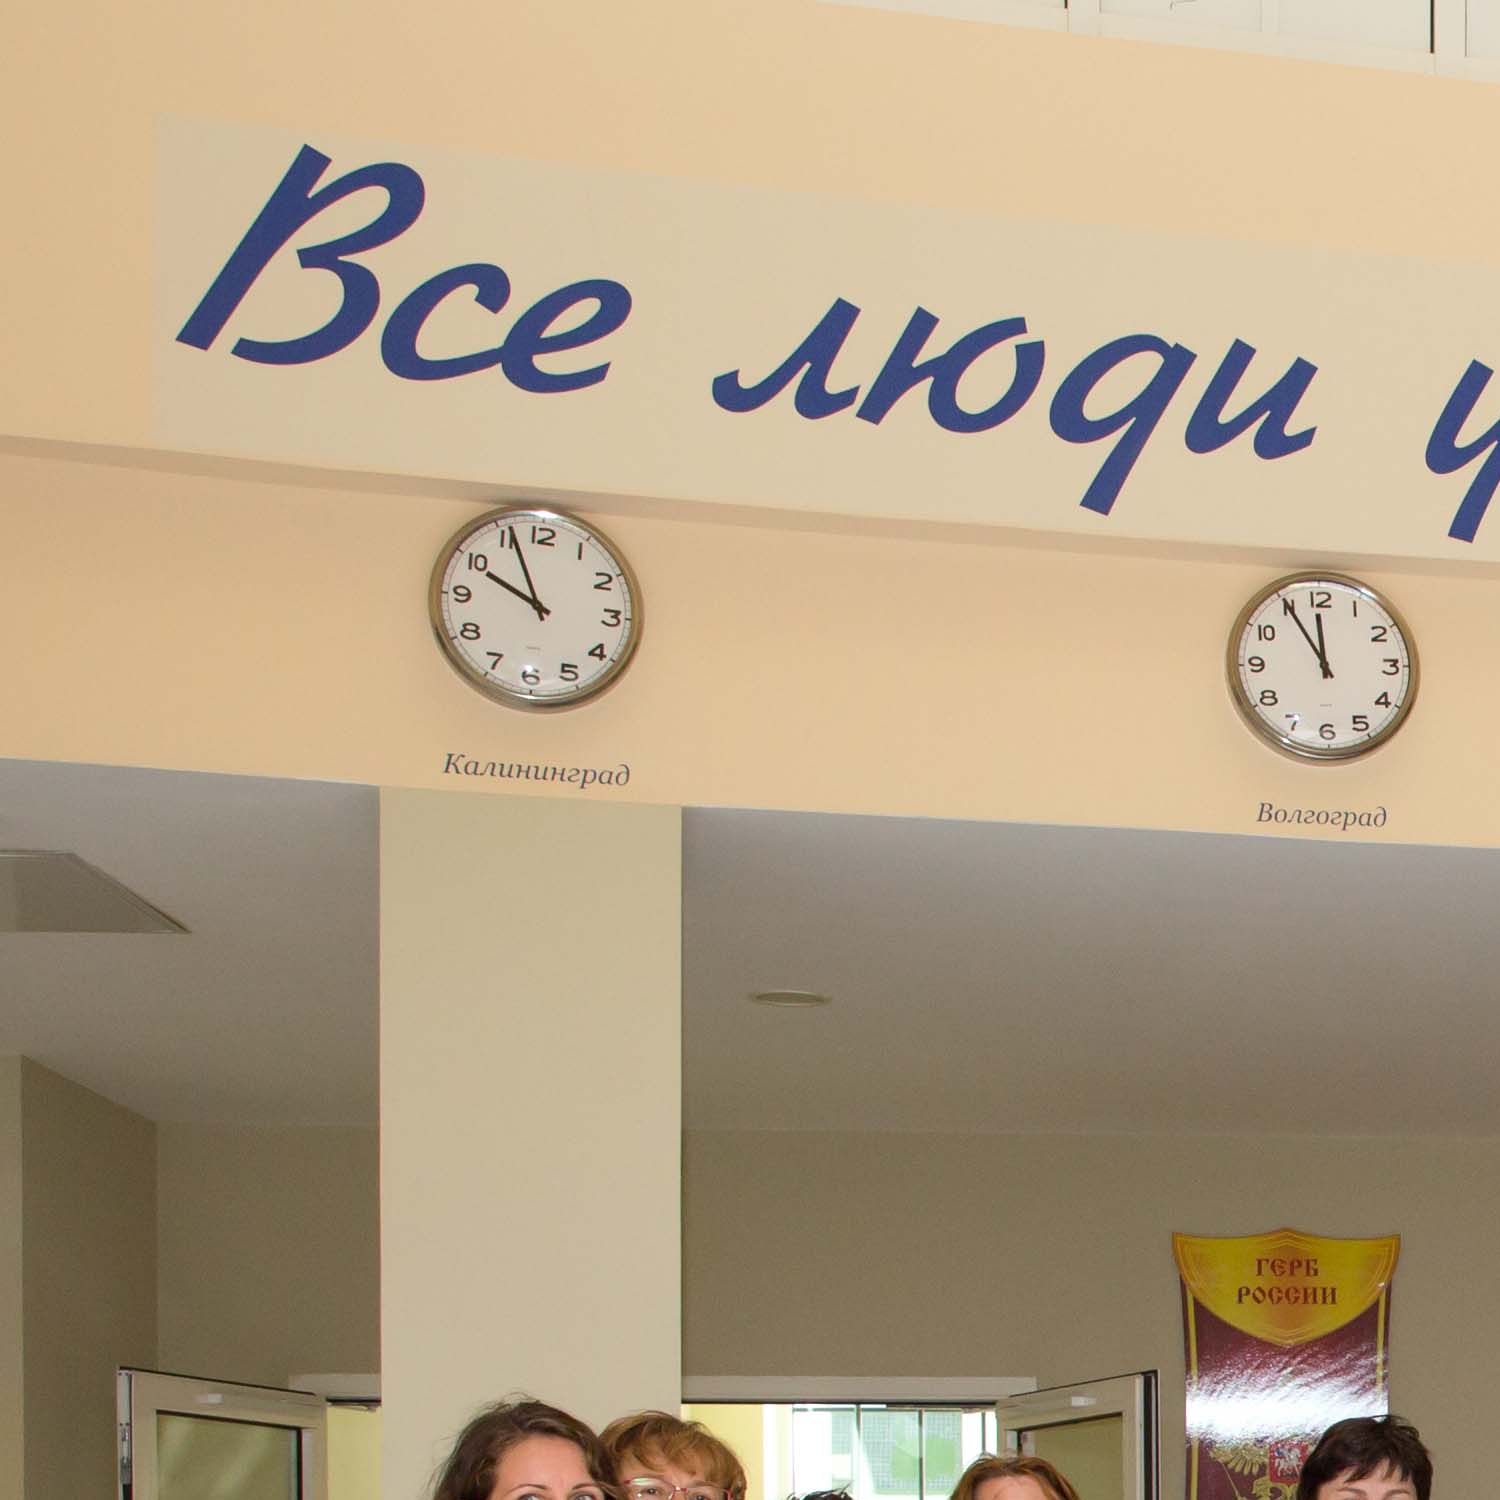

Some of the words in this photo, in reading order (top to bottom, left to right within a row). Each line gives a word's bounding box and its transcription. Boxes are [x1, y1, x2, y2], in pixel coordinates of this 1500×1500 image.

[176, 143, 632, 393] Все
[711, 298, 1317, 515] люди
[531, 525, 556, 547] 12
[578, 542, 583, 560] 1
[467, 552, 488, 572] 10
[593, 572, 613, 591] 2
[452, 584, 472, 603] 9
[1310, 591, 1332, 609] 12
[601, 608, 622, 628] 3
[1353, 600, 1357, 618] 1
[459, 622, 481, 641] 8
[1258, 624, 1275, 641] 10
[1370, 625, 1388, 643] 2
[486, 651, 504, 671] 7
[587, 643, 607, 661] 4
[559, 663, 579, 682] 5
[1248, 656, 1265, 673] 9
[1381, 658, 1399, 676] 3
[521, 667, 540, 686] 6
[1259, 689, 1278, 706] 8
[1374, 691, 1391, 709] 4
[1319, 723, 1336, 740] 6
[1352, 715, 1369, 732] 5
[442, 751, 631, 789] Калининград
[1255, 802, 1389, 832] Волгоград
[1255, 1258, 1319, 1277] ГЕРБ
[1237, 1286, 1338, 1305] РОССИИ
